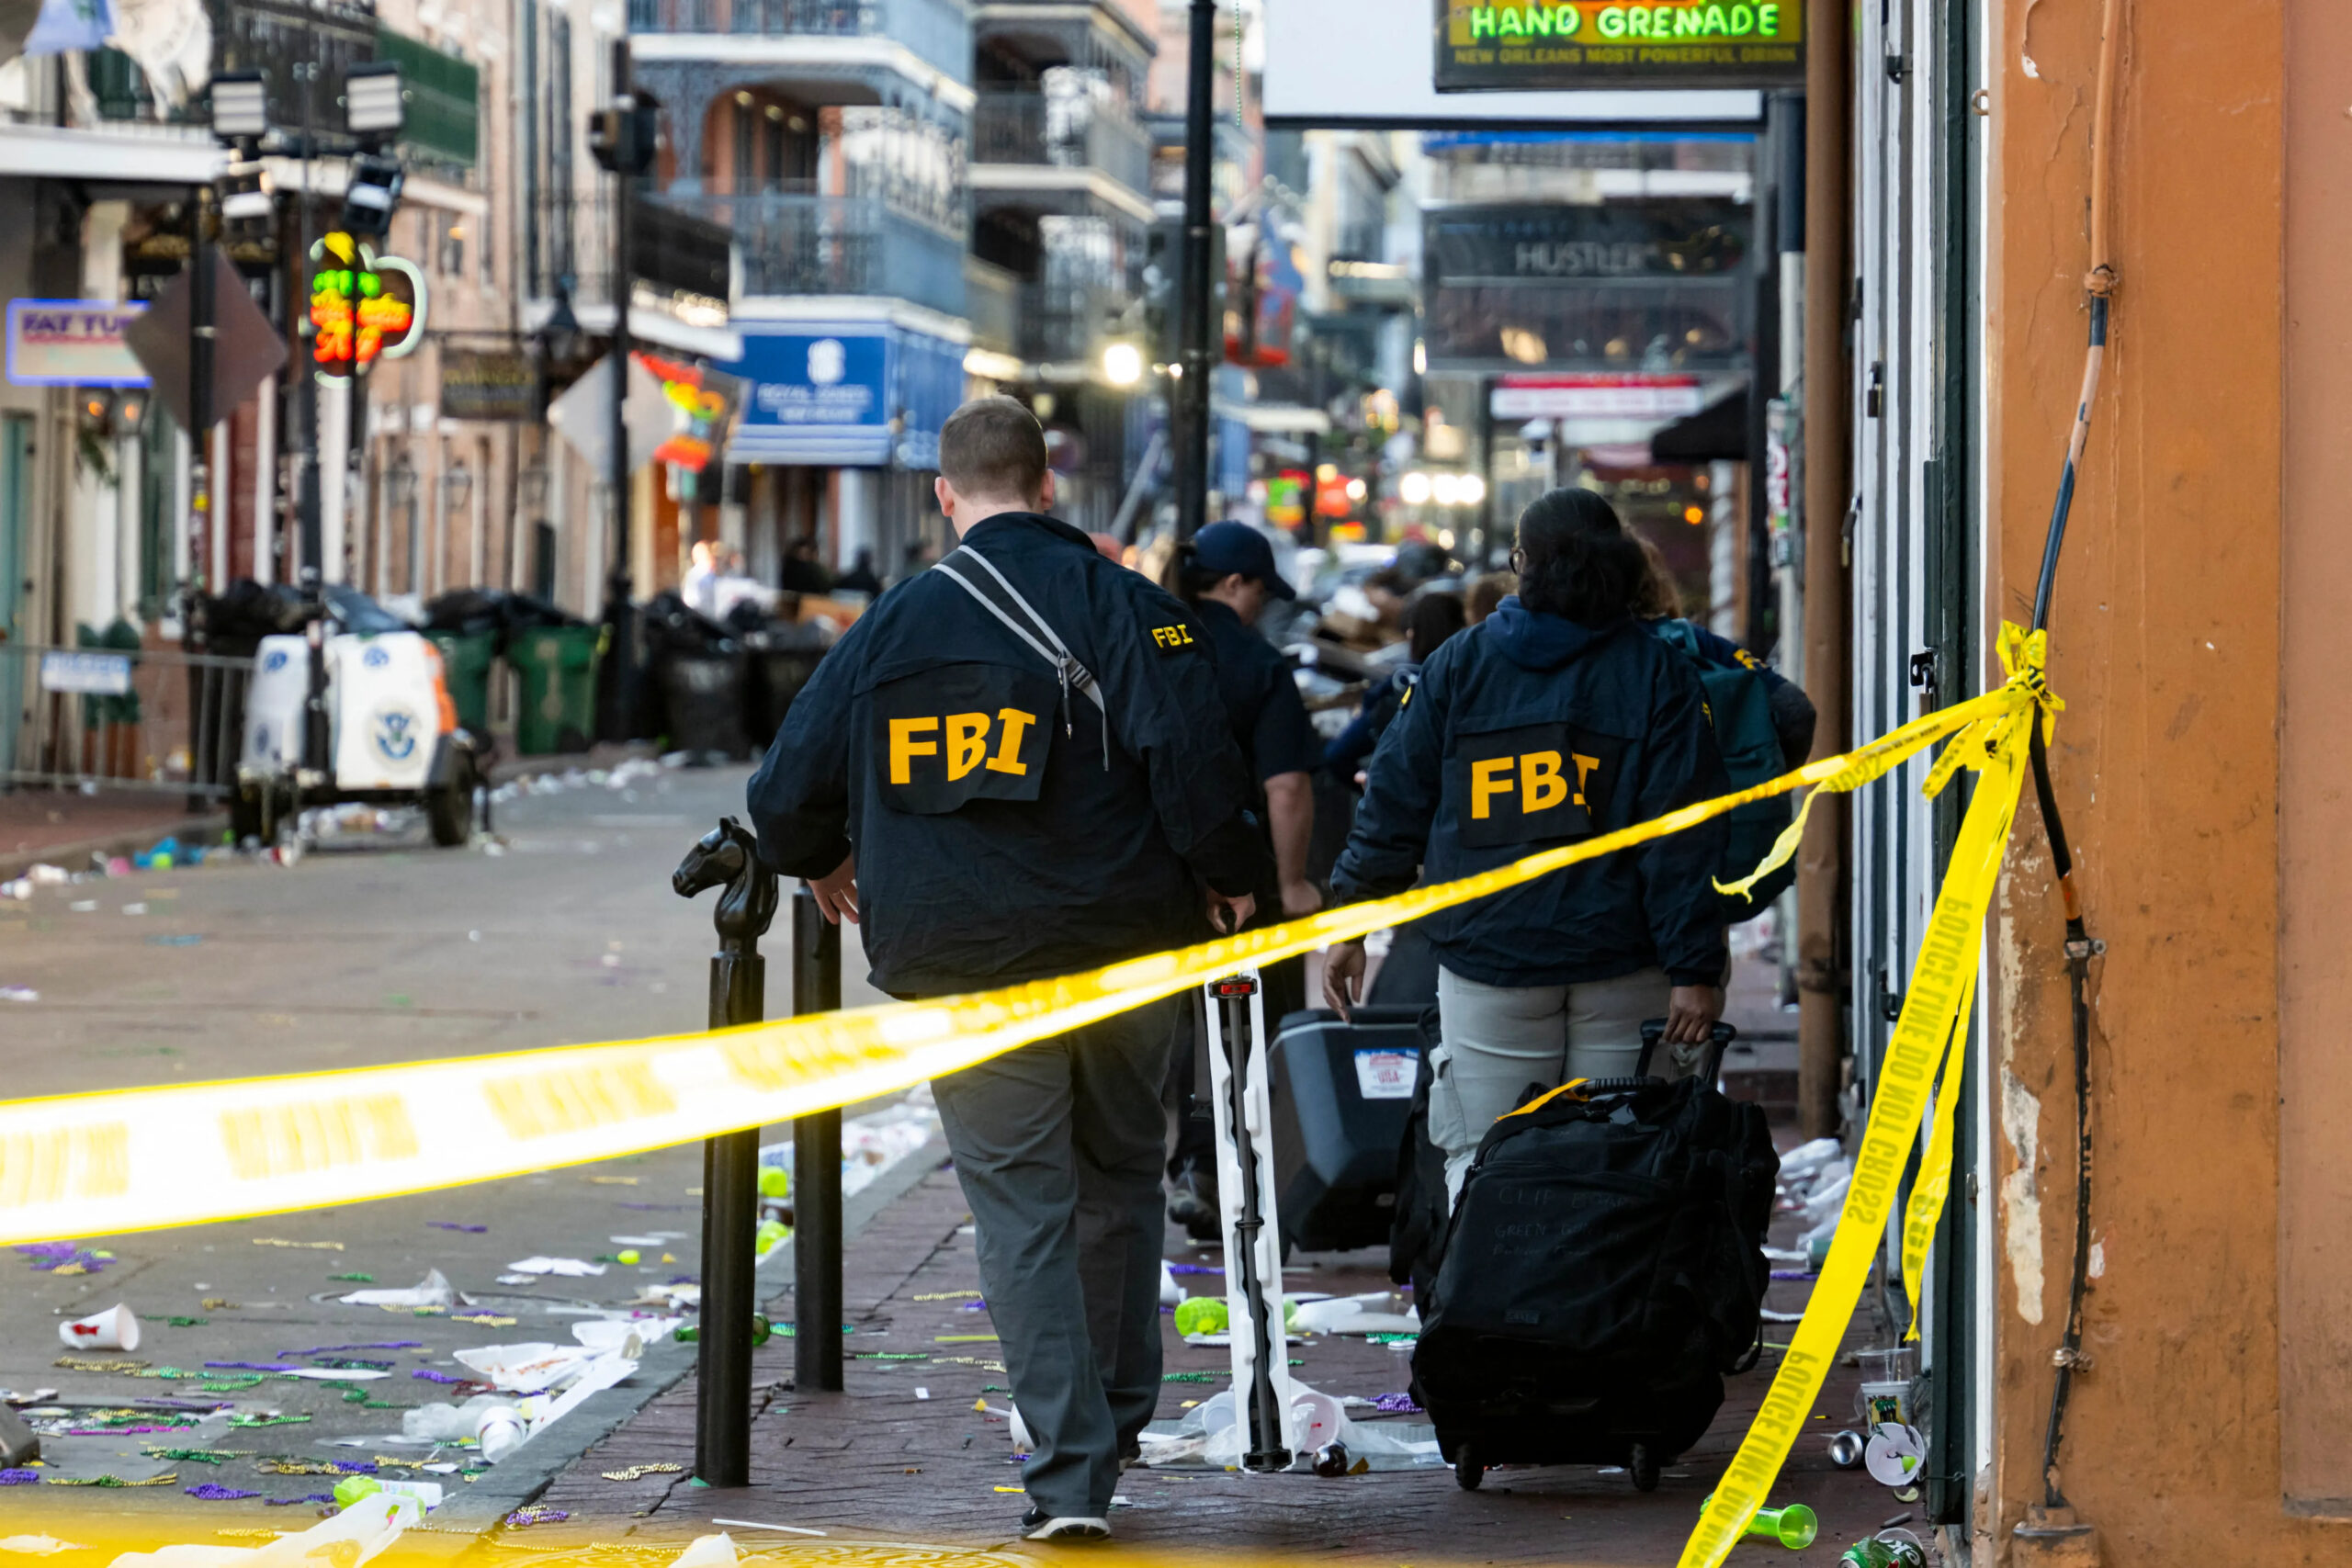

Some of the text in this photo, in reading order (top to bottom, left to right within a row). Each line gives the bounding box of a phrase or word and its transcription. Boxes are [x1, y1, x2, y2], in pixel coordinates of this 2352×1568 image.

[1471, 4, 1780, 39] HAND GRENADE
[1453, 48, 1797, 64] NEW ORLEANS MOST POWERFUL DRINK
[1514, 241, 1647, 275] HUSTLER
[22, 313, 73, 332] FAT
[1152, 624, 1194, 649] FBI
[888, 707, 1036, 784] FBI
[1472, 750, 1600, 819] FBI
[1498, 1186, 1555, 1206] CLIP
